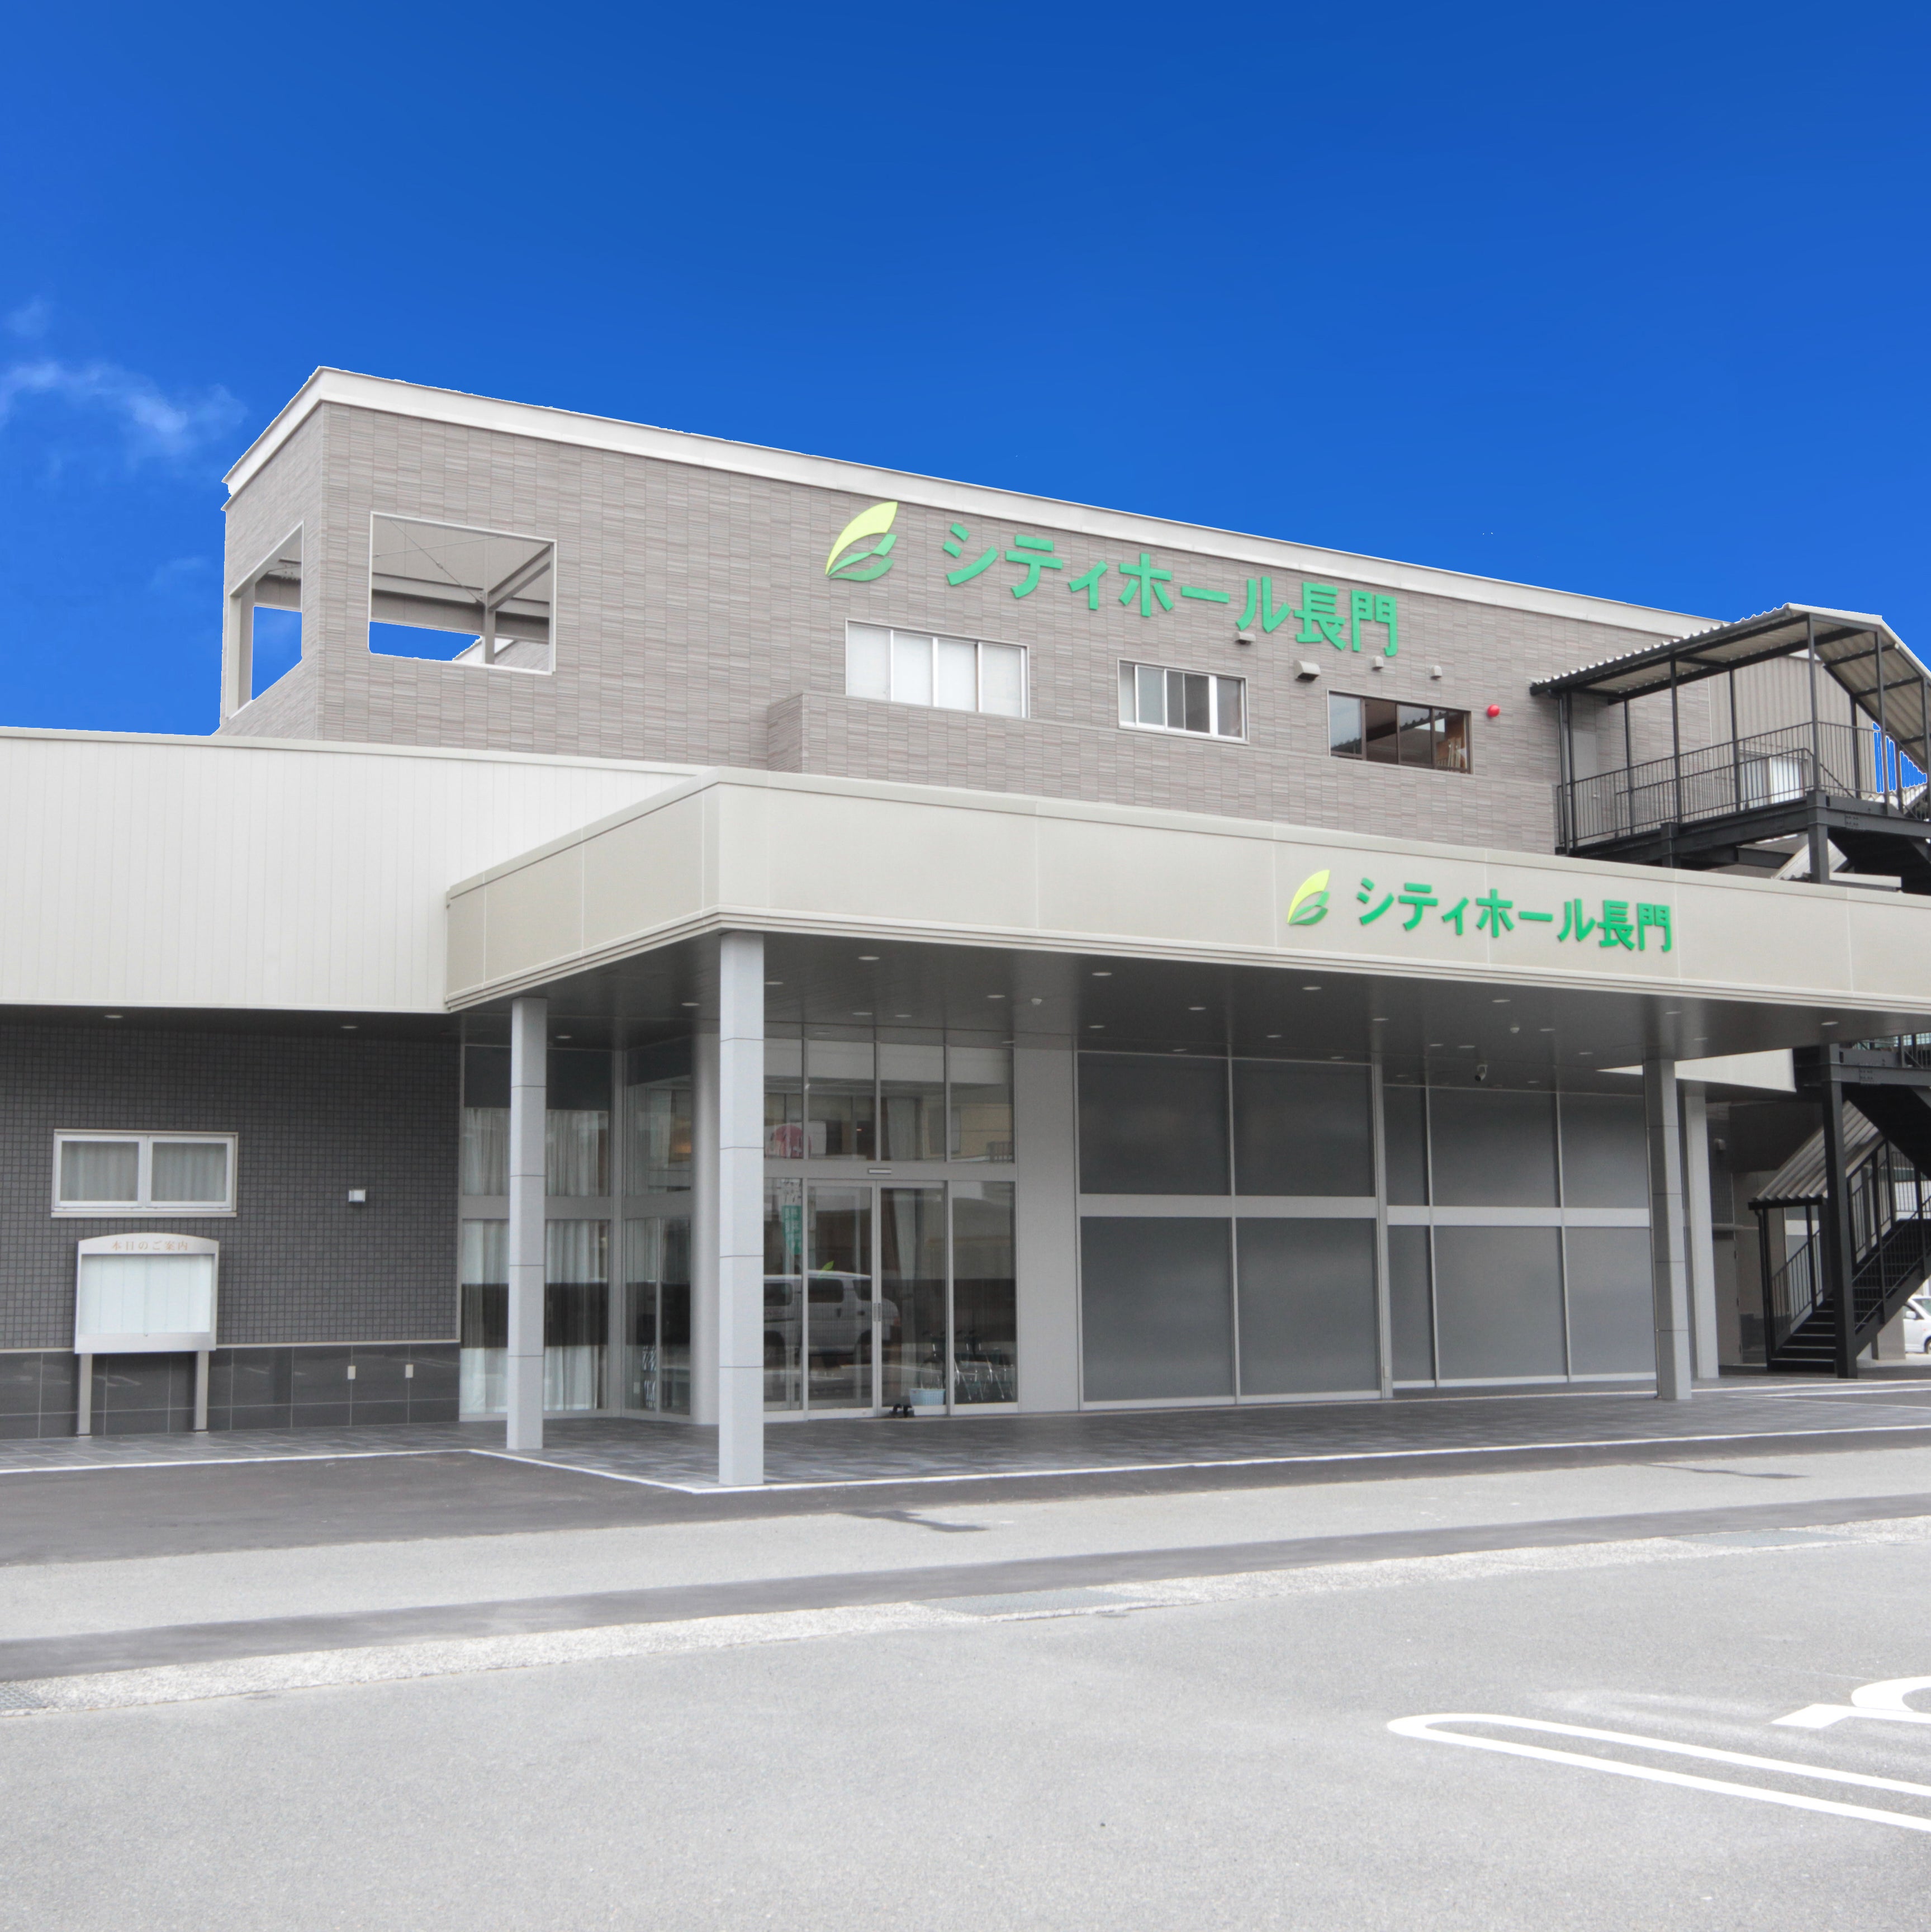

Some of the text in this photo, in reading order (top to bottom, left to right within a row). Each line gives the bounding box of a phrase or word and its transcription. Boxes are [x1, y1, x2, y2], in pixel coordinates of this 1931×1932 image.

[942, 523, 1398, 657] シティホール長門
[1356, 878, 1672, 953] シティホール長門
[111, 1240, 189, 1251] 本日のご案内
